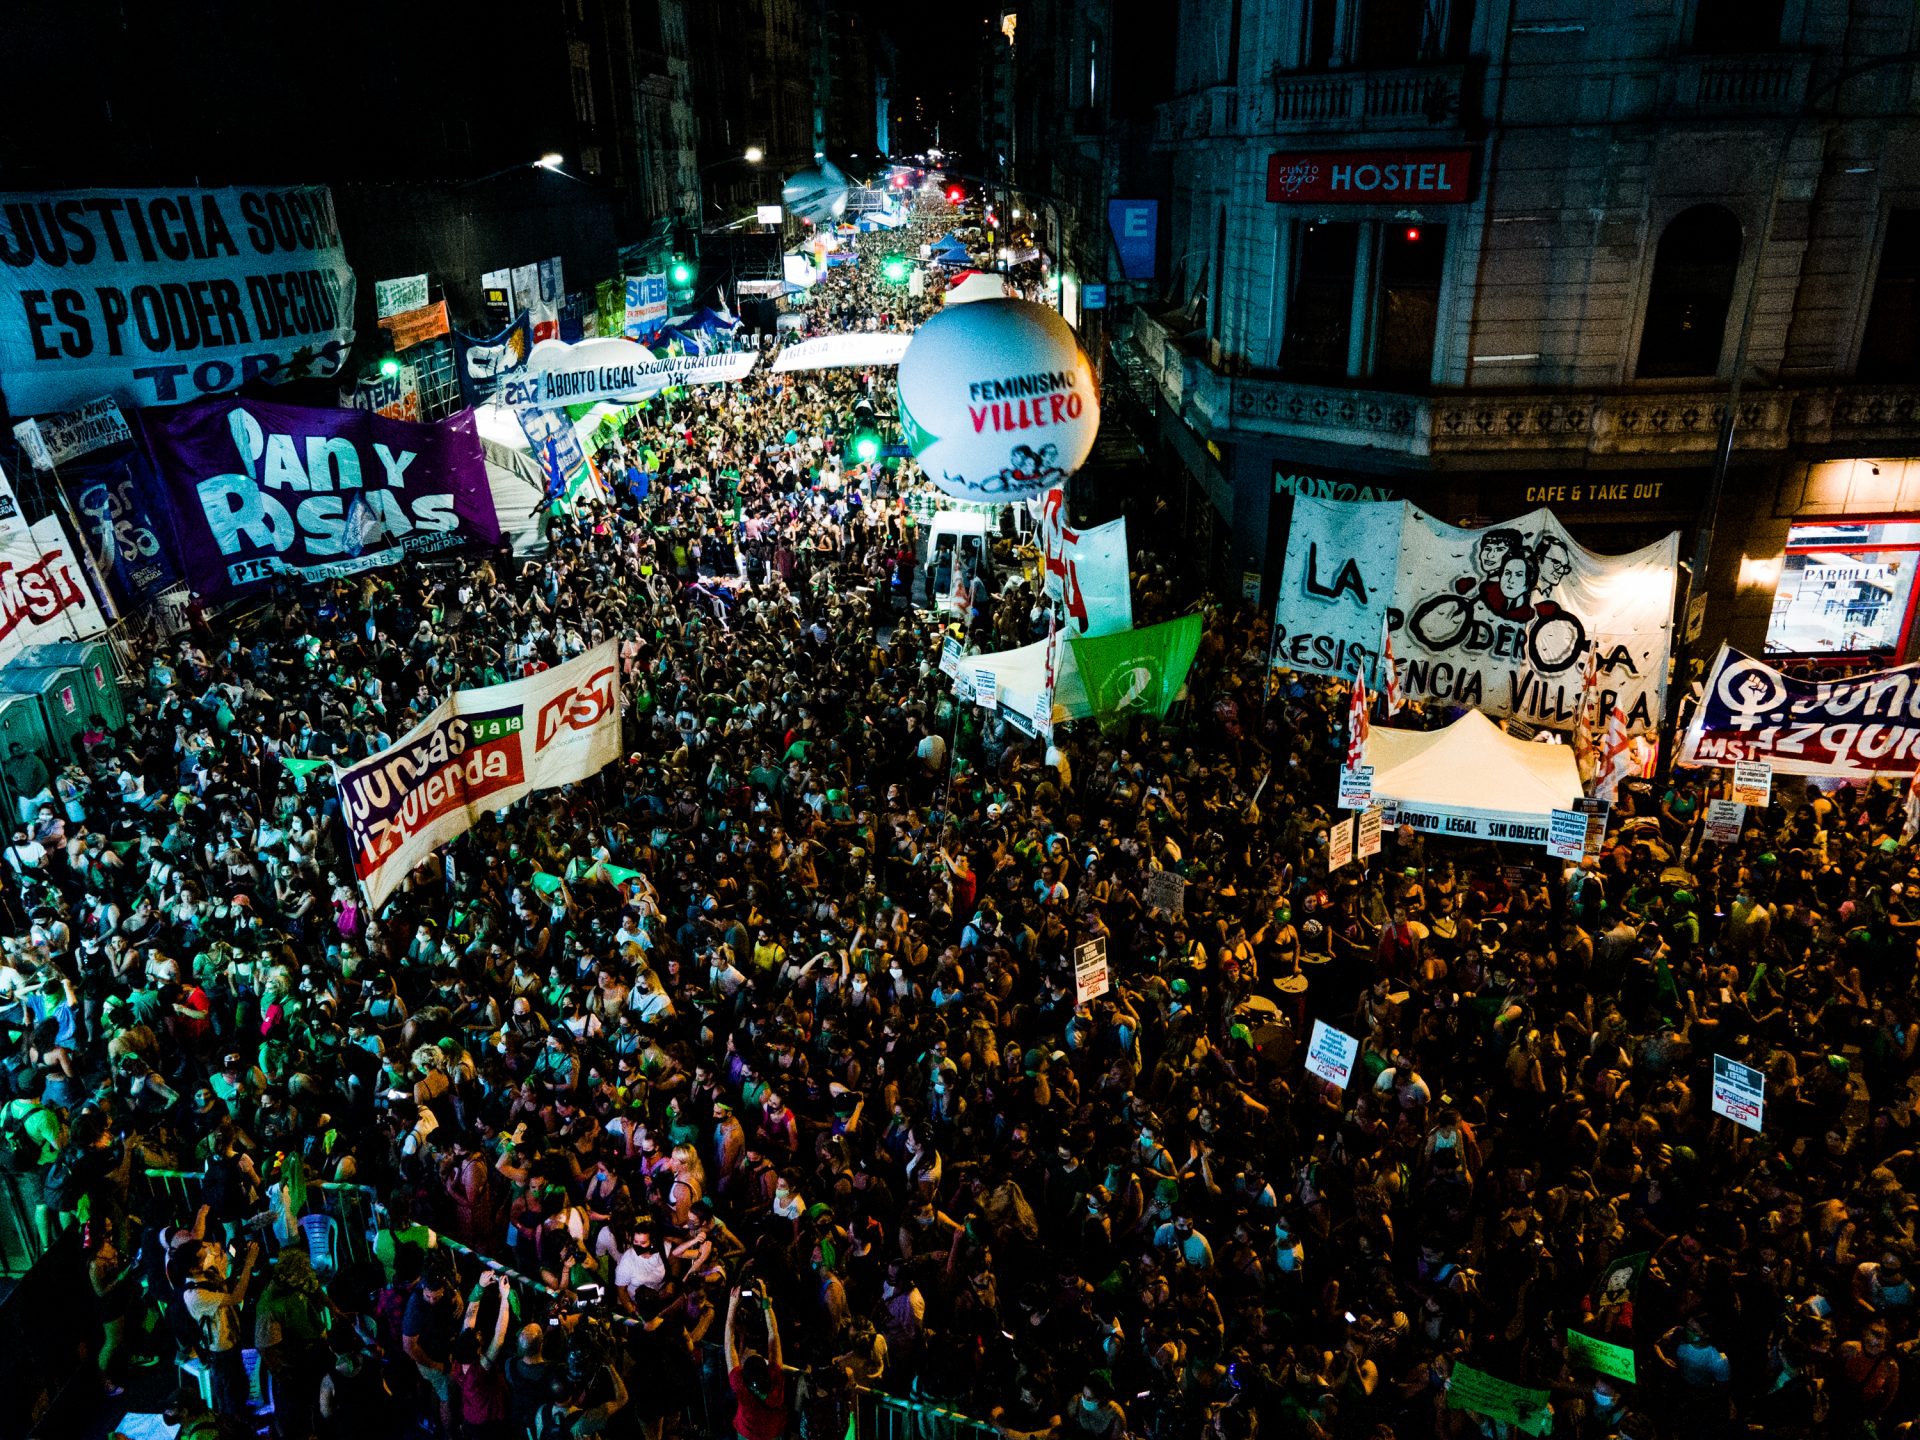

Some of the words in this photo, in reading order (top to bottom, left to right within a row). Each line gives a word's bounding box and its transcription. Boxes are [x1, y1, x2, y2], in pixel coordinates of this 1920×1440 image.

[1280, 166, 1319, 175] PUNTO
[1331, 163, 1452, 191] HOSTEL
[0, 195, 240, 268] JUSTICIA
[1125, 208, 1148, 237] E
[626, 278, 667, 308] SUTEB
[1086, 286, 1105, 308] E
[20, 288, 93, 360] ES
[96, 277, 253, 356] PODER
[132, 340, 342, 400] TODS
[546, 371, 595, 399] ABORTO
[599, 365, 637, 391] LEGAL
[636, 358, 677, 376] SEGURO
[684, 354, 737, 370] GRATUITO
[969, 370, 1075, 402] FEMINISMO
[968, 392, 1083, 434] VILLERO
[373, 443, 417, 488] Y
[1275, 471, 1395, 502] MONDAY
[1526, 485, 1567, 502] CAFE
[1571, 485, 1582, 501] &
[1589, 484, 1629, 501] TAKE
[1633, 482, 1664, 499] OUT
[404, 531, 447, 550] FRENTE
[234, 558, 275, 582] PTS
[1306, 541, 1369, 605] LA
[1804, 568, 1884, 580] PARRILLA
[0, 553, 82, 626] MST
[473, 727, 484, 739] y
[489, 723, 500, 735] a
[505, 716, 521, 732] la
[1700, 738, 1757, 761] MST
[1395, 810, 1439, 831] ABORTO
[1445, 817, 1478, 835] LEGAL
[1488, 822, 1507, 838] SIN
